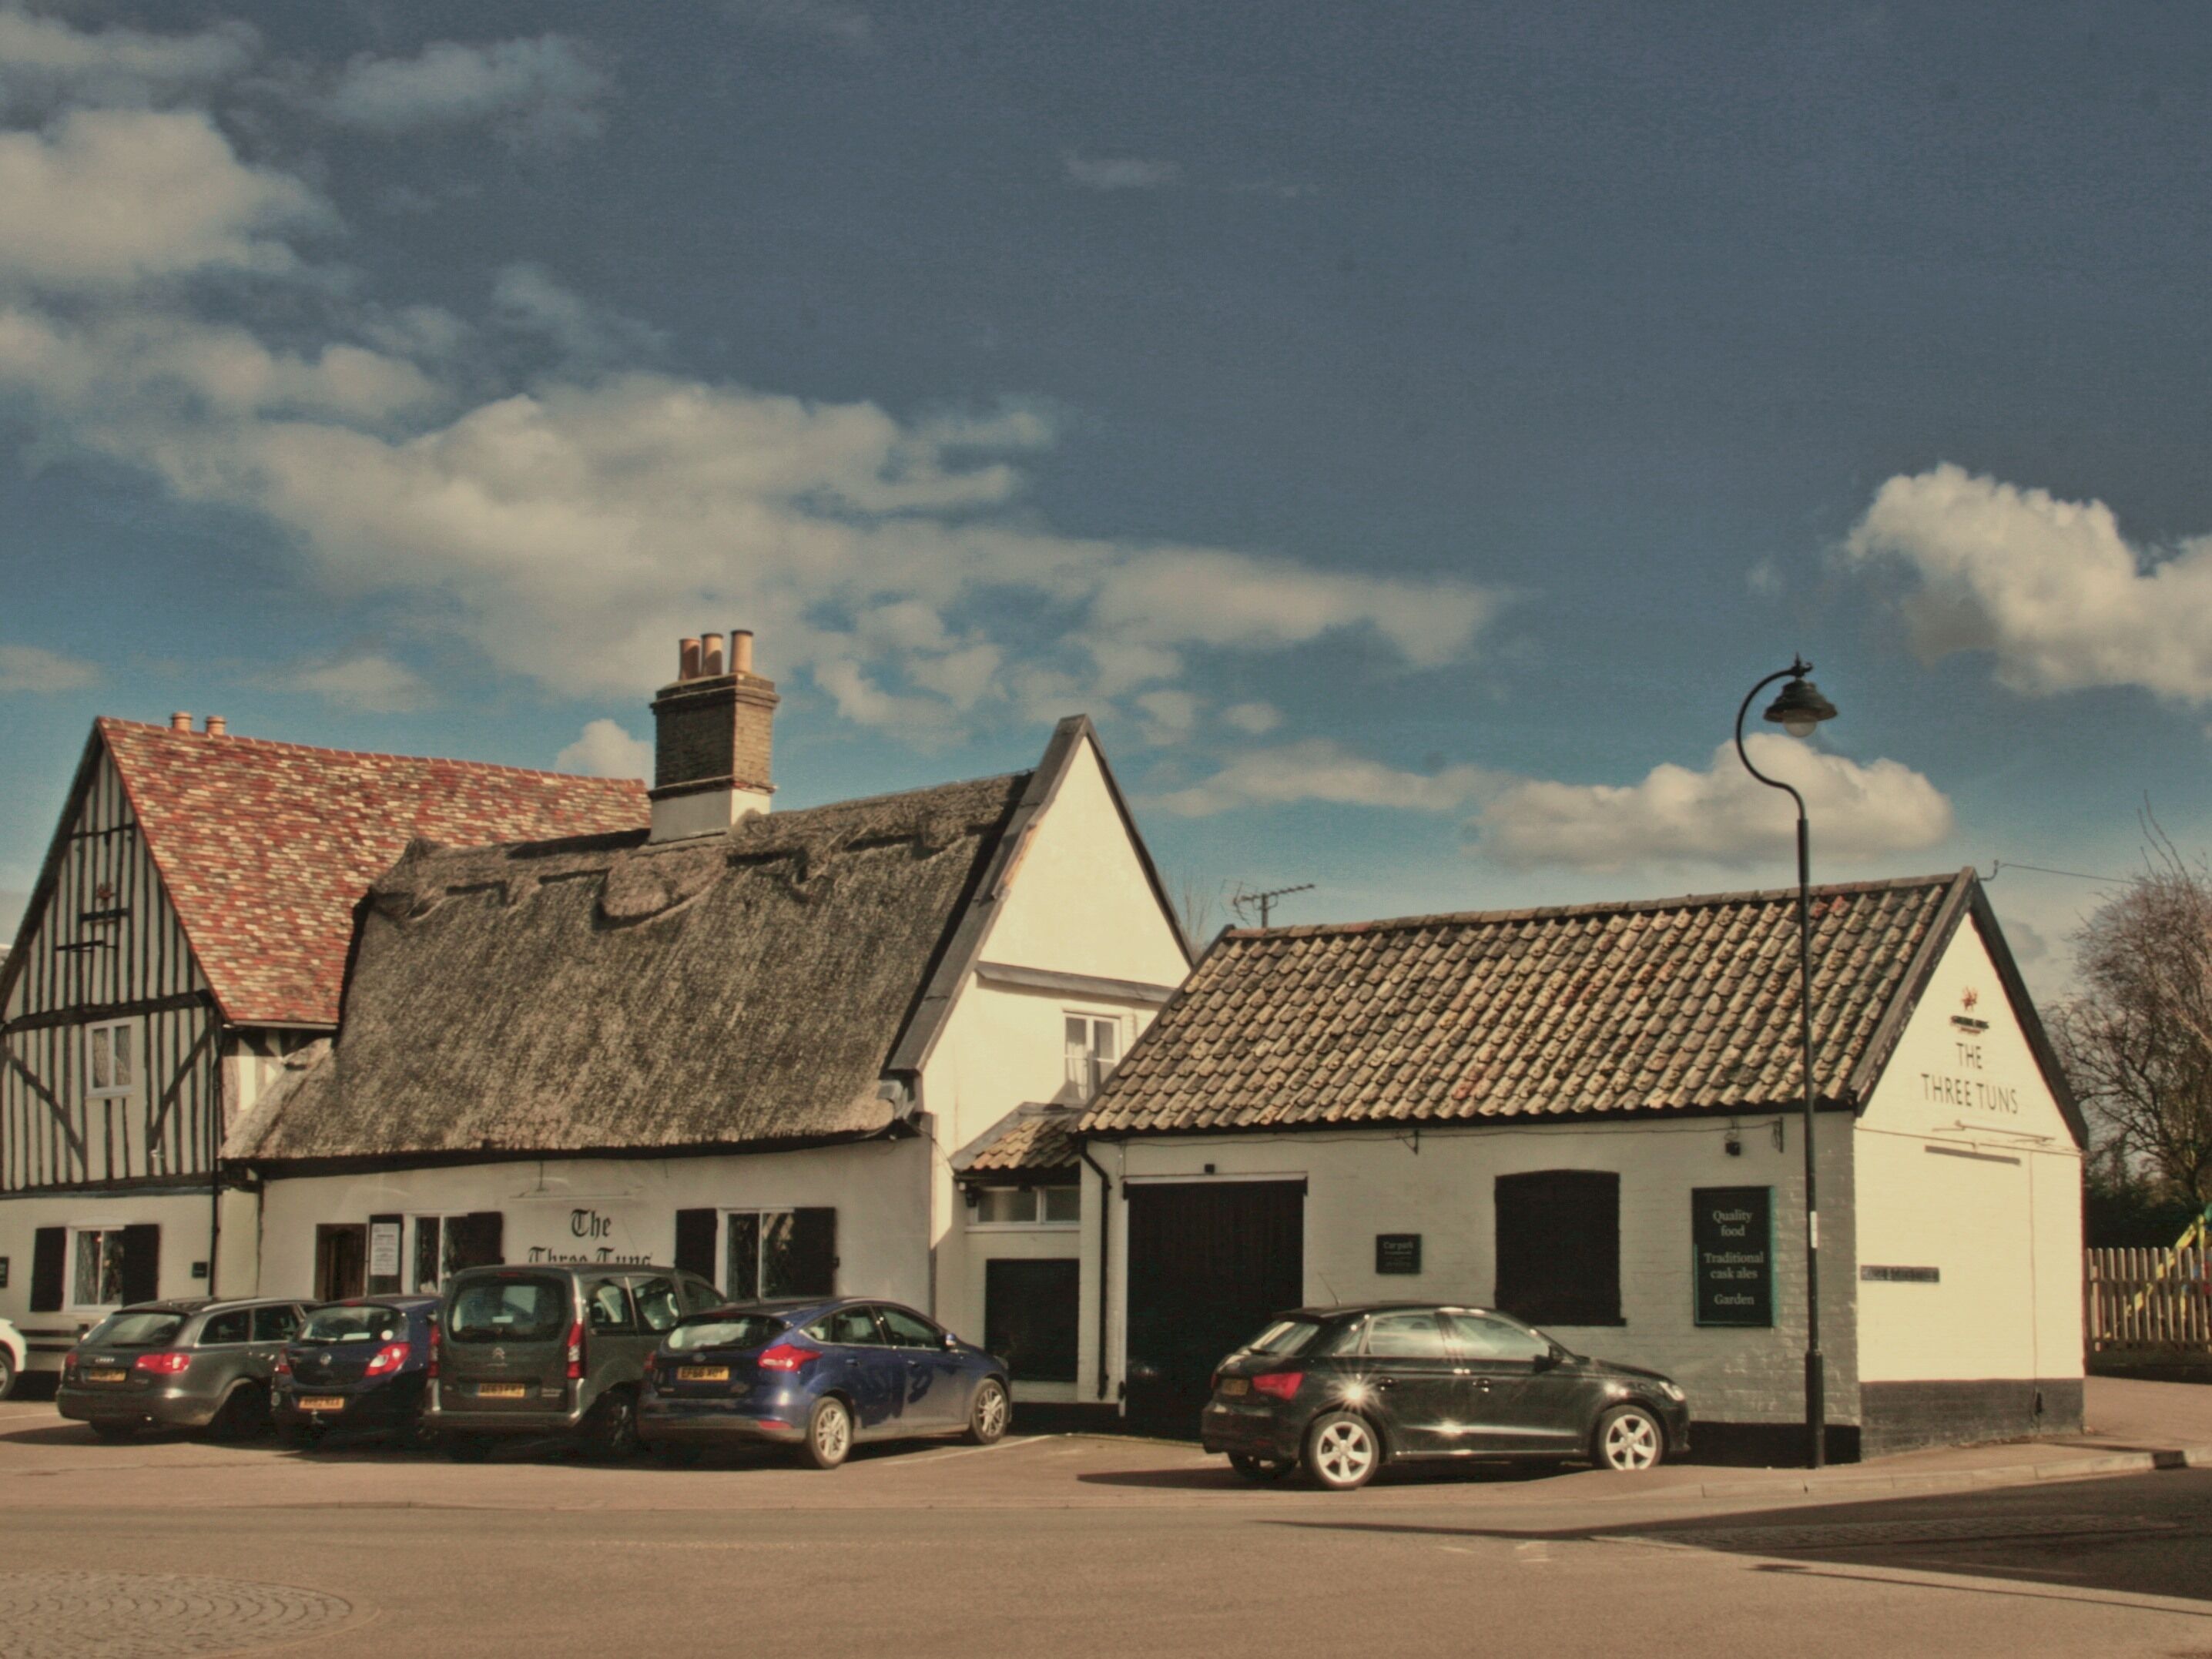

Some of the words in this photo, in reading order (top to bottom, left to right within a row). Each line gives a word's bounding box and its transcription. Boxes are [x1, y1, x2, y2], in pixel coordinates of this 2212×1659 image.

[1956, 1042, 1982, 1070] THE
[1921, 1073, 1972, 1108] THREE
[1976, 1082, 2018, 1114] TUNS
[1712, 1209, 1753, 1223] Quality
[571, 1208, 611, 1240] The
[1721, 1225, 1745, 1236] food
[1704, 1252, 1764, 1263] Traditional
[1710, 1267, 1734, 1279] cask
[1736, 1267, 1758, 1279] ales
[1714, 1293, 1755, 1305] Garden
